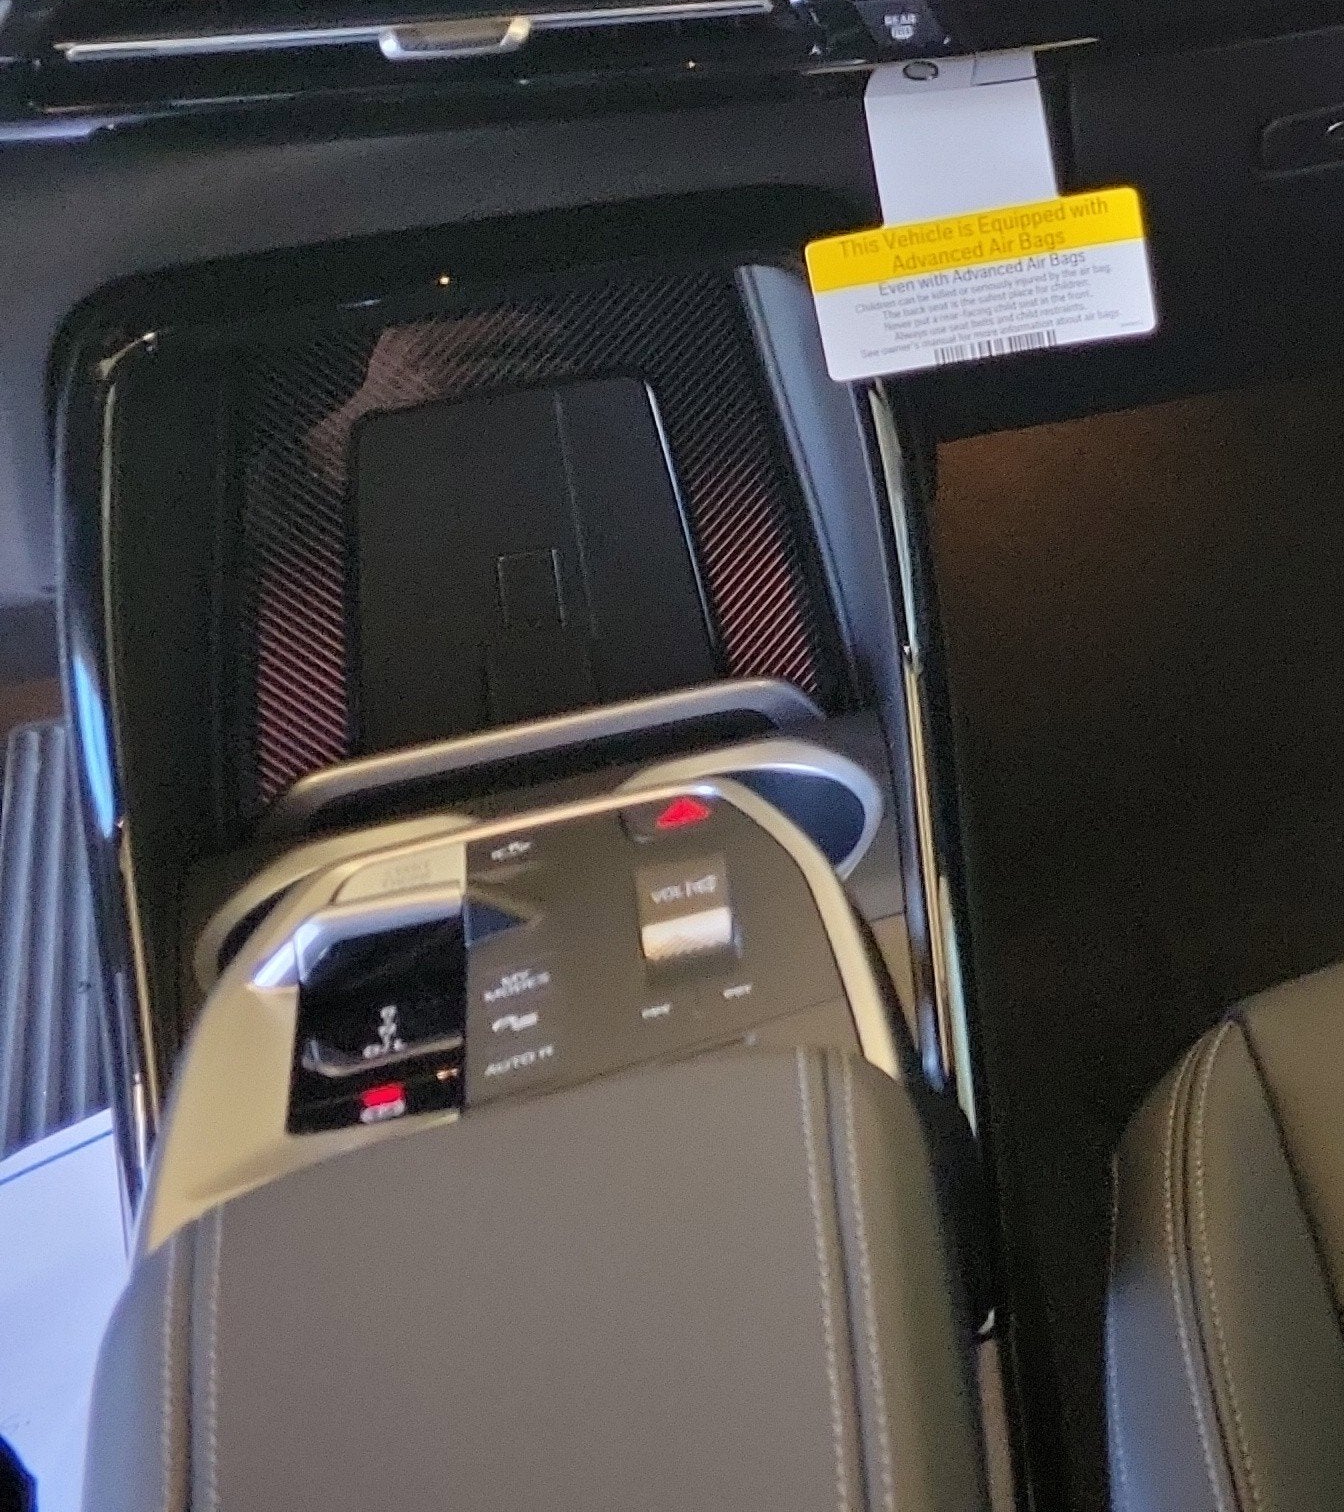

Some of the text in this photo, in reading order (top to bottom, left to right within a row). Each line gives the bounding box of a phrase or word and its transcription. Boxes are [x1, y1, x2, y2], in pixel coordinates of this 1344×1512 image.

[839, 198, 1109, 256] This Vehicle is Equipped with
[890, 229, 1067, 270] Advanced Air Bags
[877, 251, 1086, 296] Even with Advanced Air Bags
